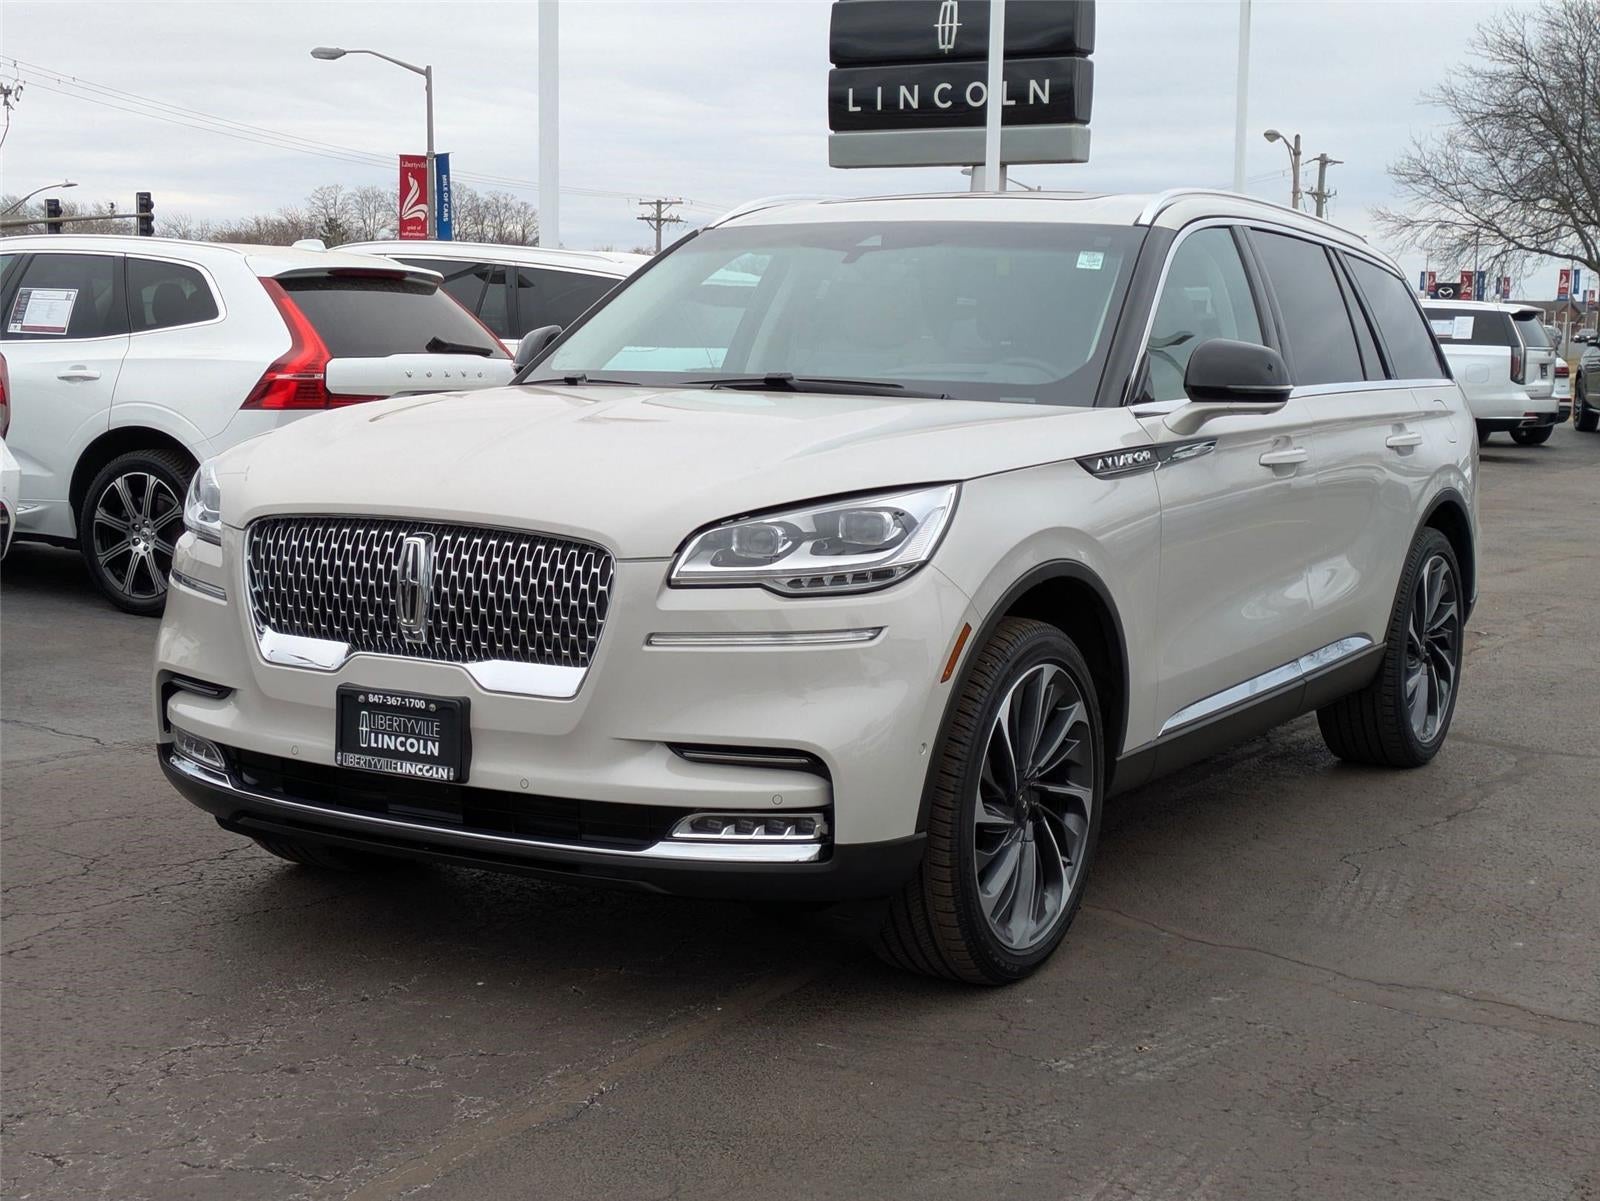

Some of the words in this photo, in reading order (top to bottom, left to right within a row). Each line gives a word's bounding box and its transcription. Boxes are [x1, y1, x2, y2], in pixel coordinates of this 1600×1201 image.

[848, 79, 1050, 112] LINCOLN
[404, 367, 484, 378] VOLVO
[1096, 450, 1150, 470] AVIATOR
[368, 693, 426, 709] 847-367-1700
[370, 713, 440, 738] LIBERTYVILLE
[370, 733, 439, 757] LINCOLN
